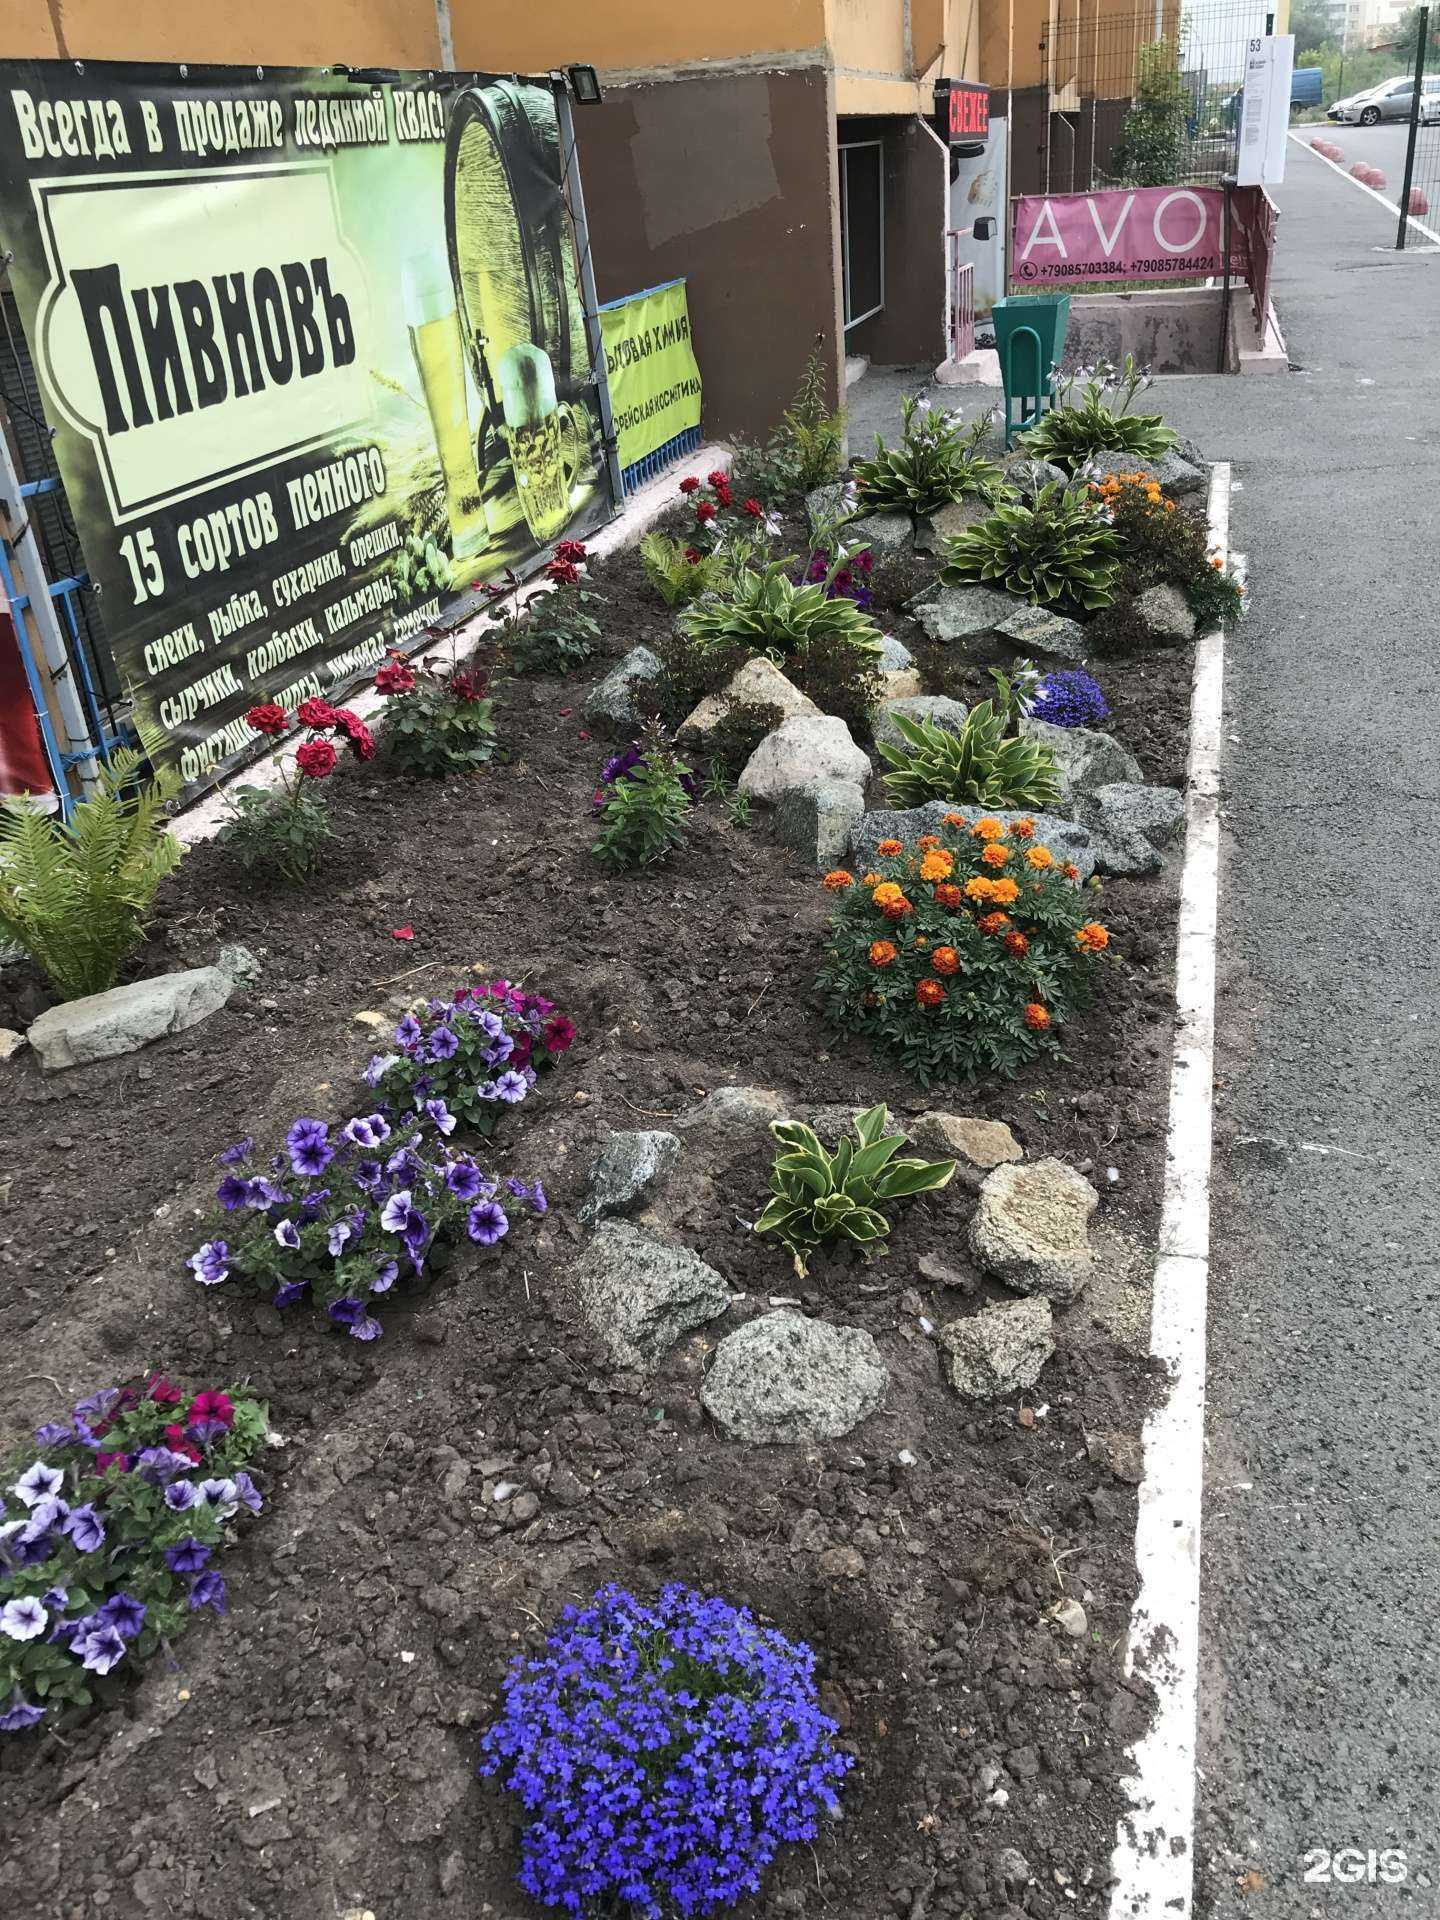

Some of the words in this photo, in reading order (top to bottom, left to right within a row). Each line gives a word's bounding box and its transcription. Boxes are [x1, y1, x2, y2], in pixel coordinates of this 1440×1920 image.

[1250, 38, 1261, 52] 53
[11, 89, 132, 161] Всегда
[143, 101, 161, 153] в
[173, 100, 283, 157] продаже
[294, 91, 388, 148] ледянной
[392, 90, 446, 139] КВАС!
[1130, 256, 1214, 273] +79085784424
[604, 330, 653, 374] ЫТОВАЯ
[653, 316, 689, 352] ХИМИЯ
[613, 398, 655, 436] ОРЕЙСКАЯ
[119, 527, 165, 605] 15
[177, 492, 279, 580] сортов
[286, 447, 386, 530] пенного
[144, 622, 205, 675] снеки,
[208, 590, 269, 645] рыбка,
[272, 549, 347, 608] сухарики,
[350, 521, 404, 568] орешки,
[159, 663, 244, 730] сырчики,
[247, 618, 324, 680] колбаски,
[324, 575, 398, 635] кальмары,
